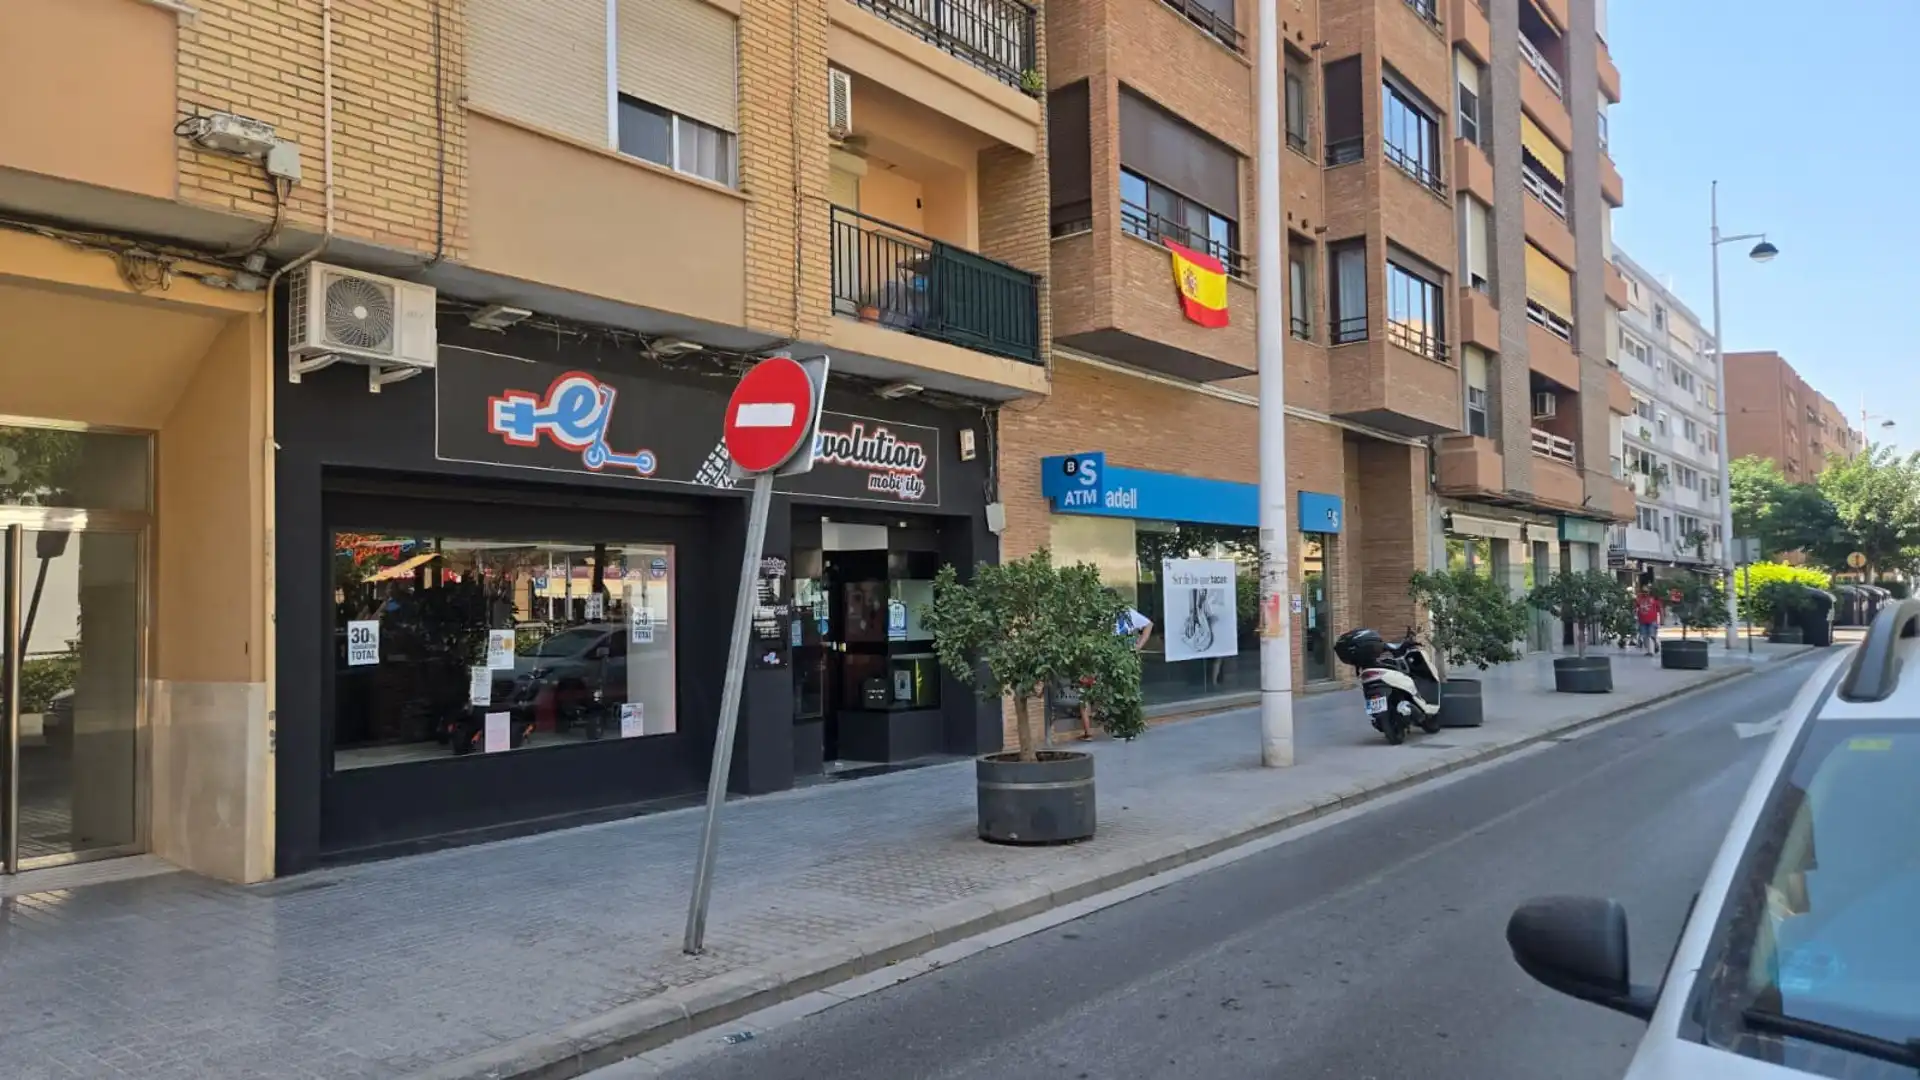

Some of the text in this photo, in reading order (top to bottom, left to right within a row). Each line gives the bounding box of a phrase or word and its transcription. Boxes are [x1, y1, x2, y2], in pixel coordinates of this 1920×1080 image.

[1064, 488, 1098, 506] ATM
[1105, 486, 1137, 509] adell
[351, 649, 376, 661] TOTAL
